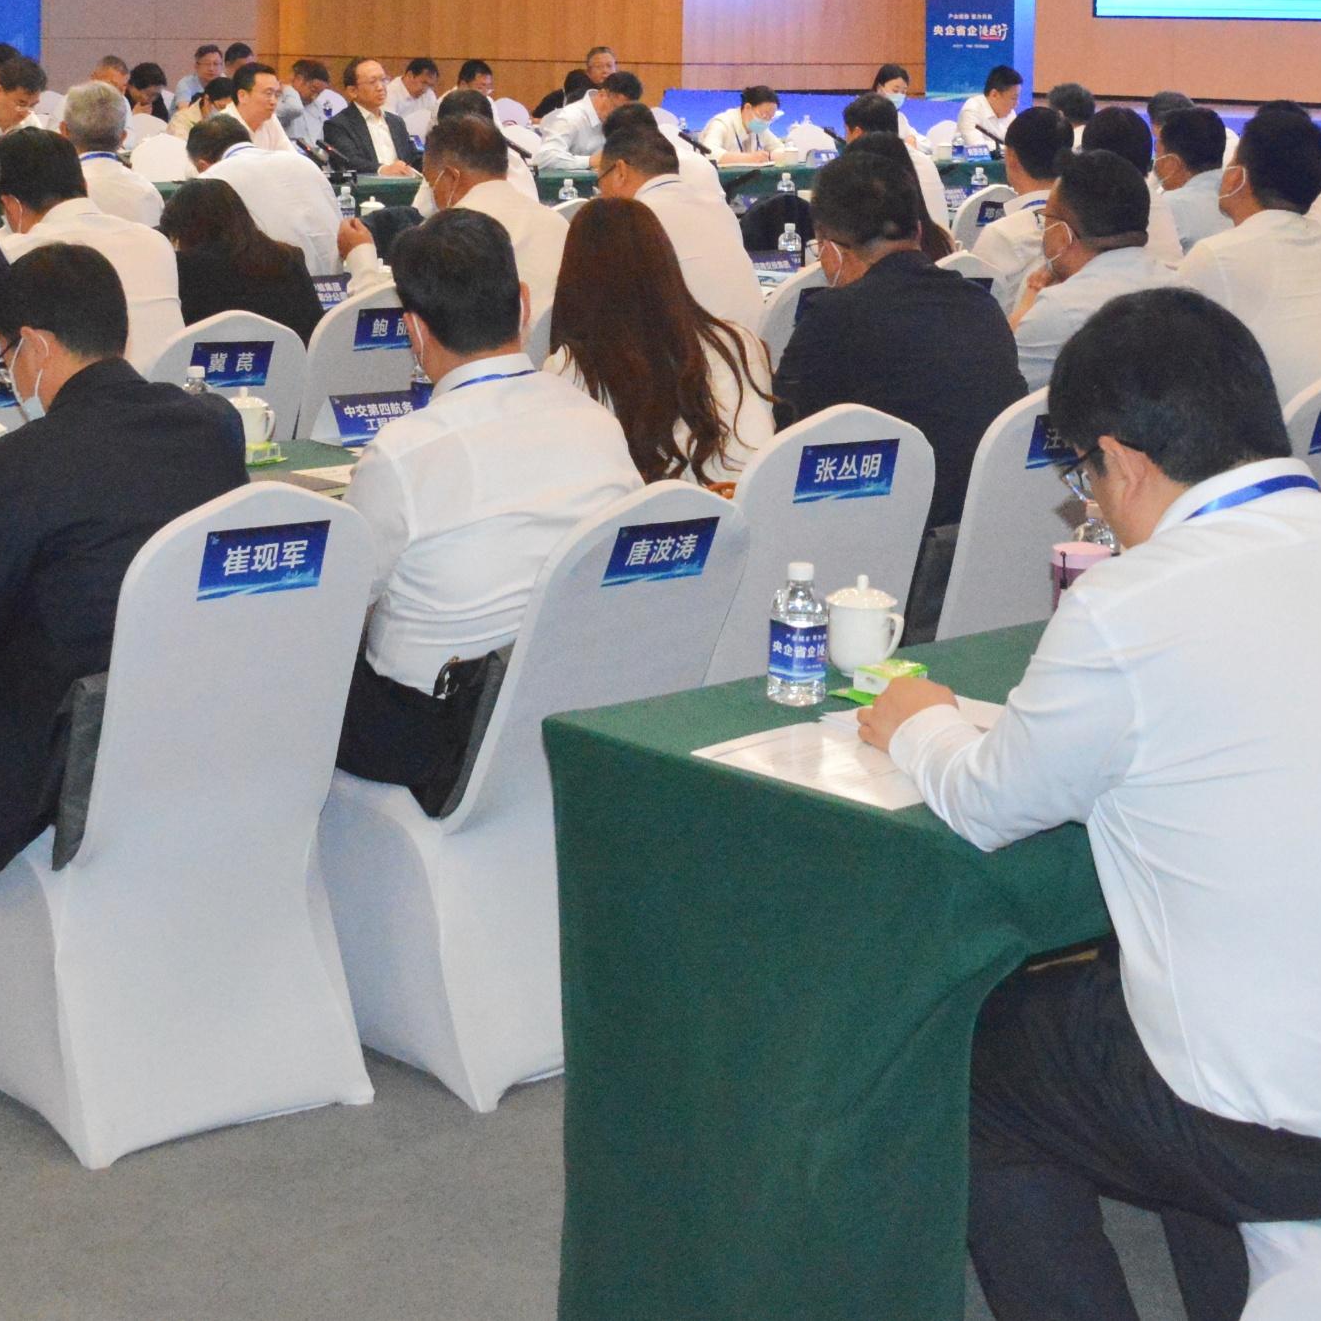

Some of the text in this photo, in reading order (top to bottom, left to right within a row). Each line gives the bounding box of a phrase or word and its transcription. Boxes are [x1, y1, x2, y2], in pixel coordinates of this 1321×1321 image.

[343, 401, 413, 418] 中交第四航务
[365, 417, 396, 431] 工程
[814, 453, 883, 483] 张丛明
[222, 539, 309, 577] 崔现军
[624, 533, 699, 567] 唐波涛
